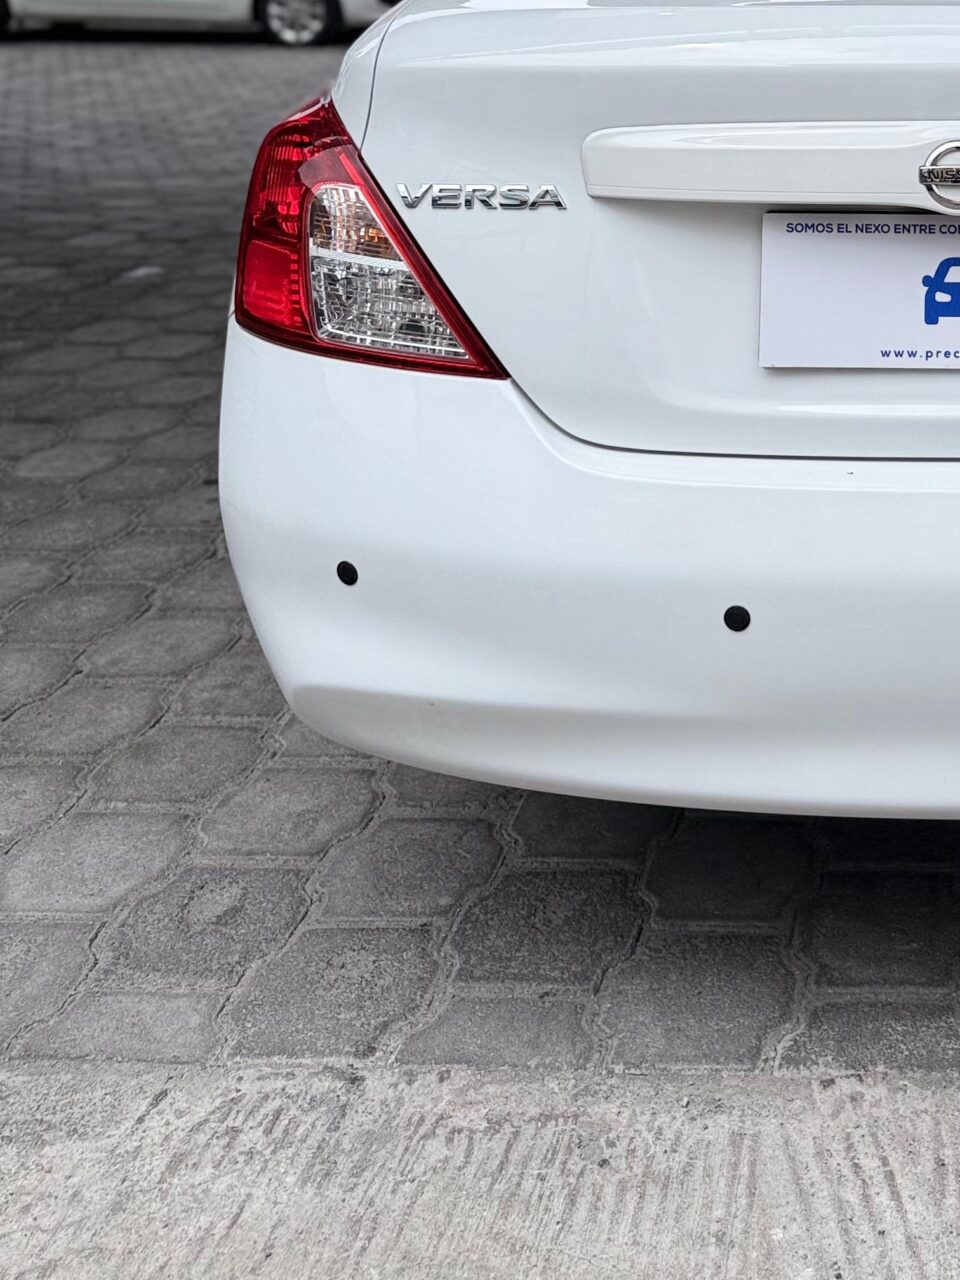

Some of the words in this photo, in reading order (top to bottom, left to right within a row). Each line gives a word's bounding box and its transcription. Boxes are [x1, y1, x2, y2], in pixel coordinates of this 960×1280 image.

[396, 183, 567, 210] VERSA
[786, 222, 834, 234] SOMOS
[837, 223, 852, 234] EL
[855, 224, 891, 234] NEXO
[894, 224, 936, 235] ENTRE
